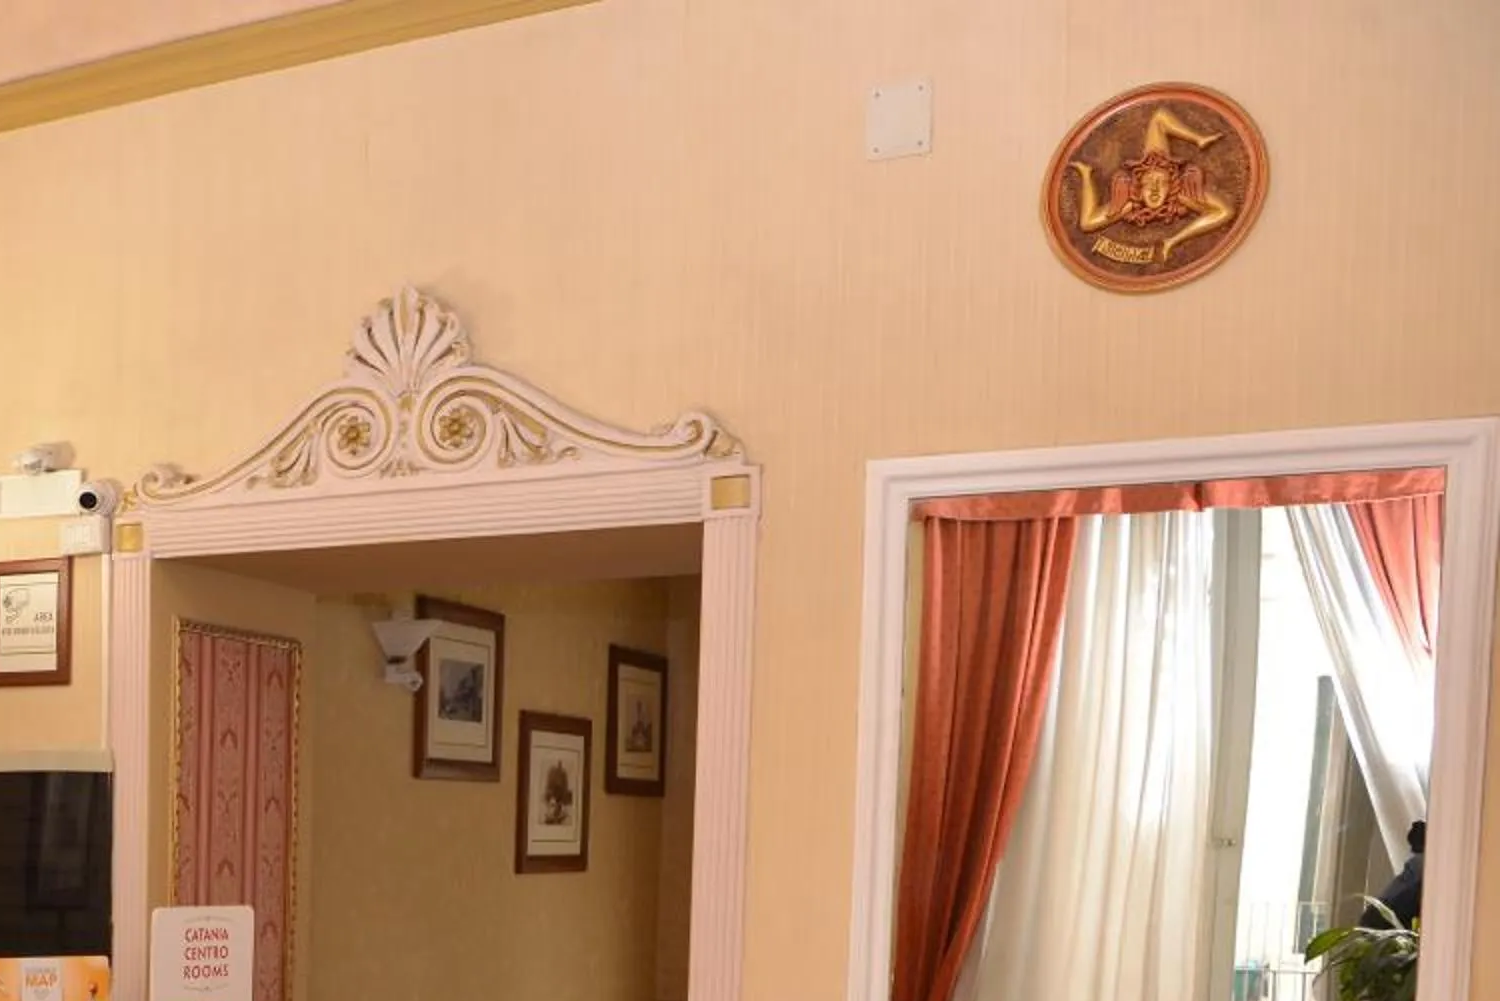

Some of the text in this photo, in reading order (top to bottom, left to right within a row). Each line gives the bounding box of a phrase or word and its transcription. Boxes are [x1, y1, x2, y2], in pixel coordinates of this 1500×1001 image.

[184, 927, 229, 943] CATANIA
[184, 945, 229, 960] CENTRO
[183, 964, 229, 980] ROOMS
